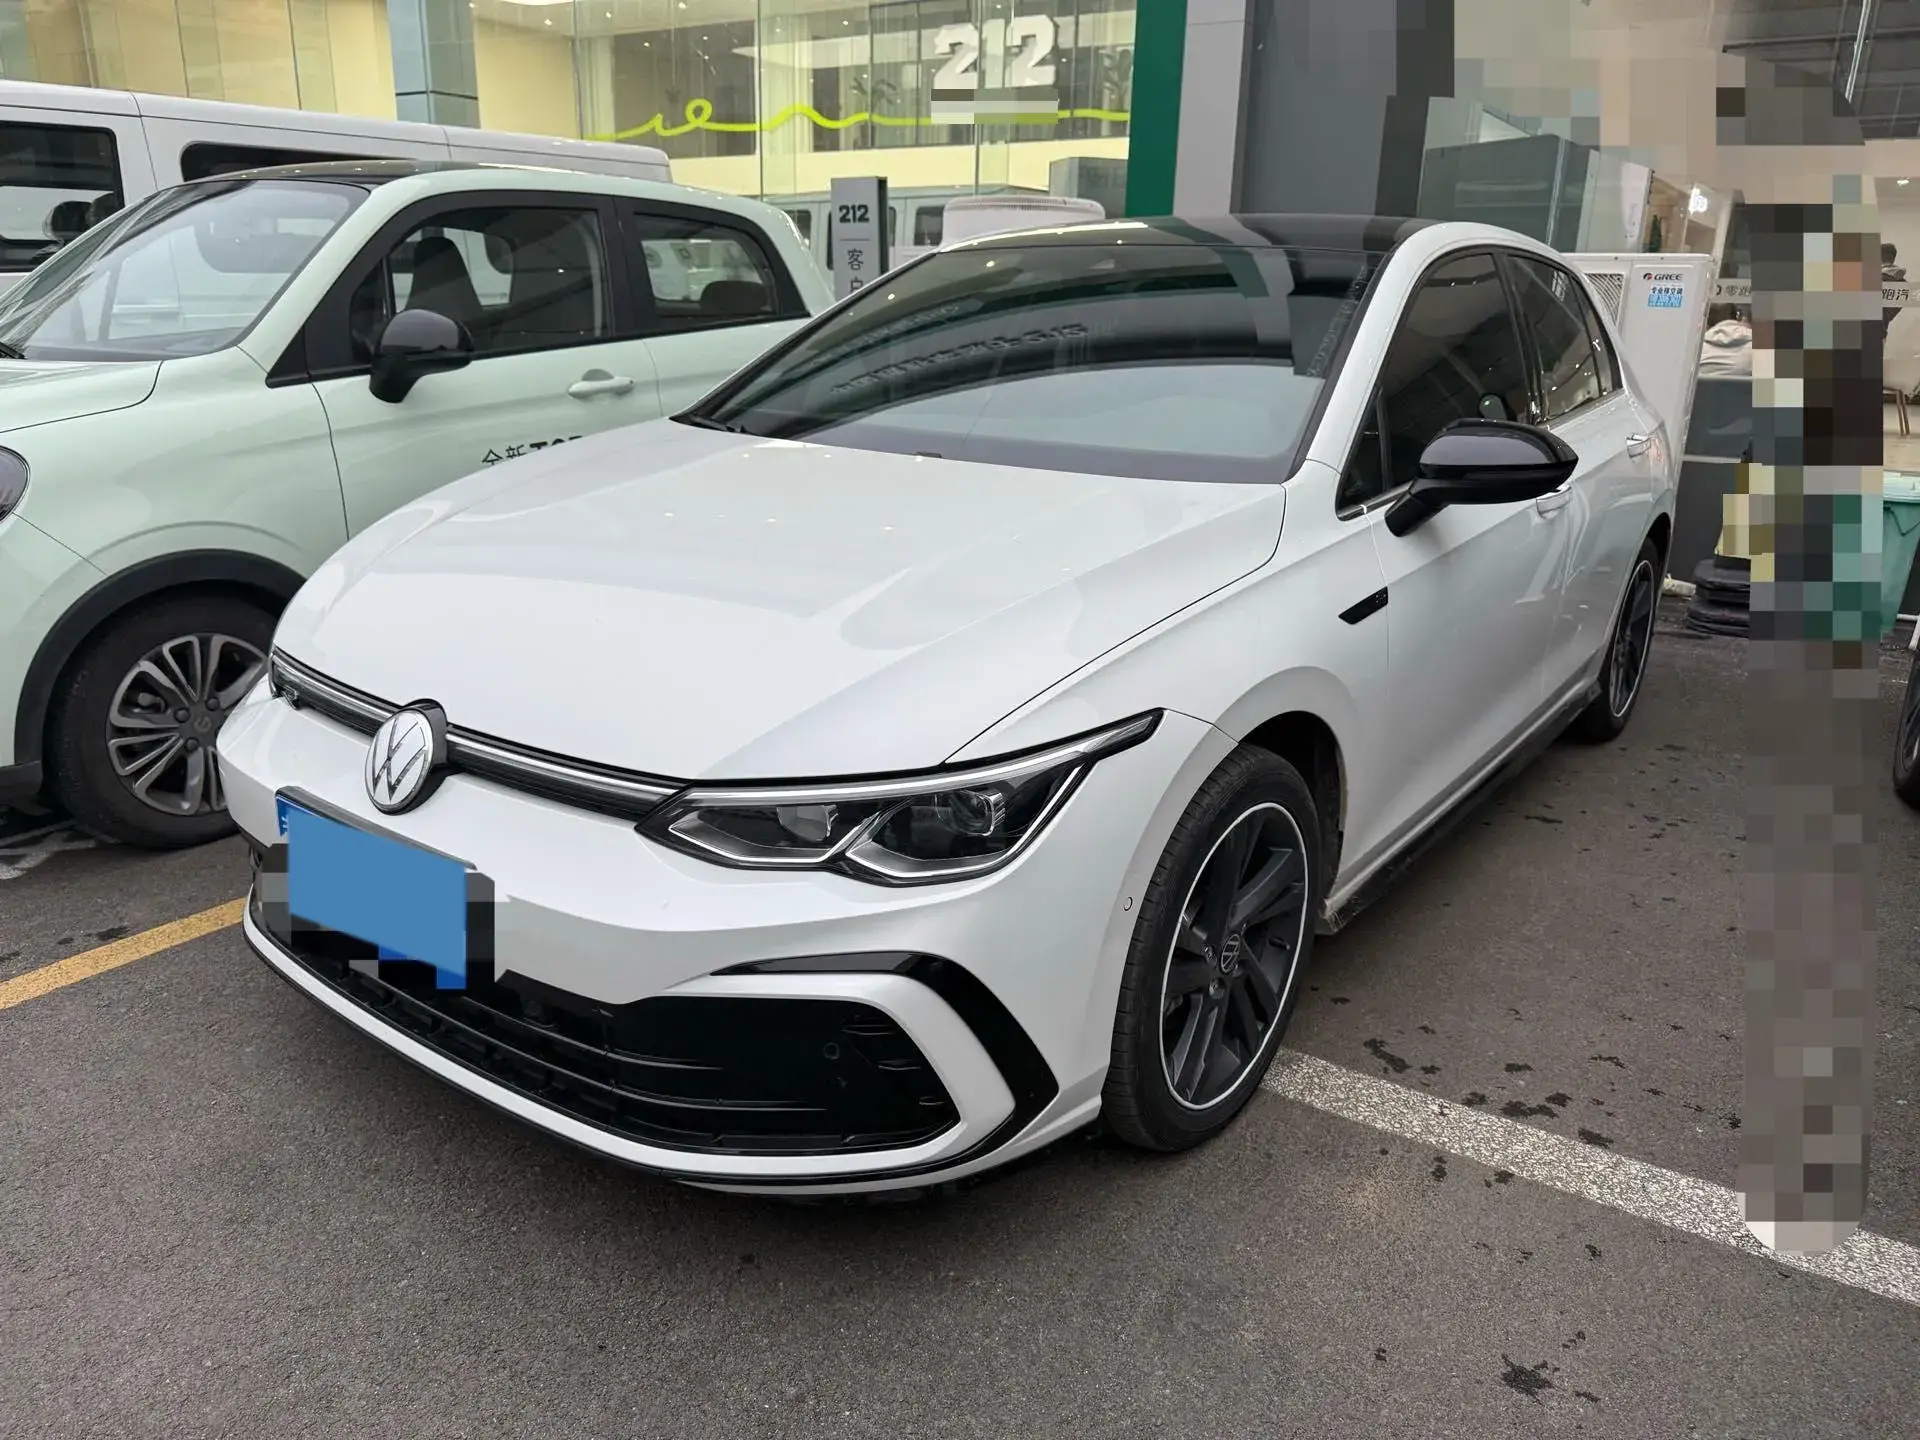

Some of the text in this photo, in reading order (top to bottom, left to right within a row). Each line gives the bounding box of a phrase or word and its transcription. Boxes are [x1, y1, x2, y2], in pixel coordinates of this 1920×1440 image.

[933, 14, 1057, 89] 212
[838, 203, 870, 223] 212
[1654, 273, 1684, 281] GREE
